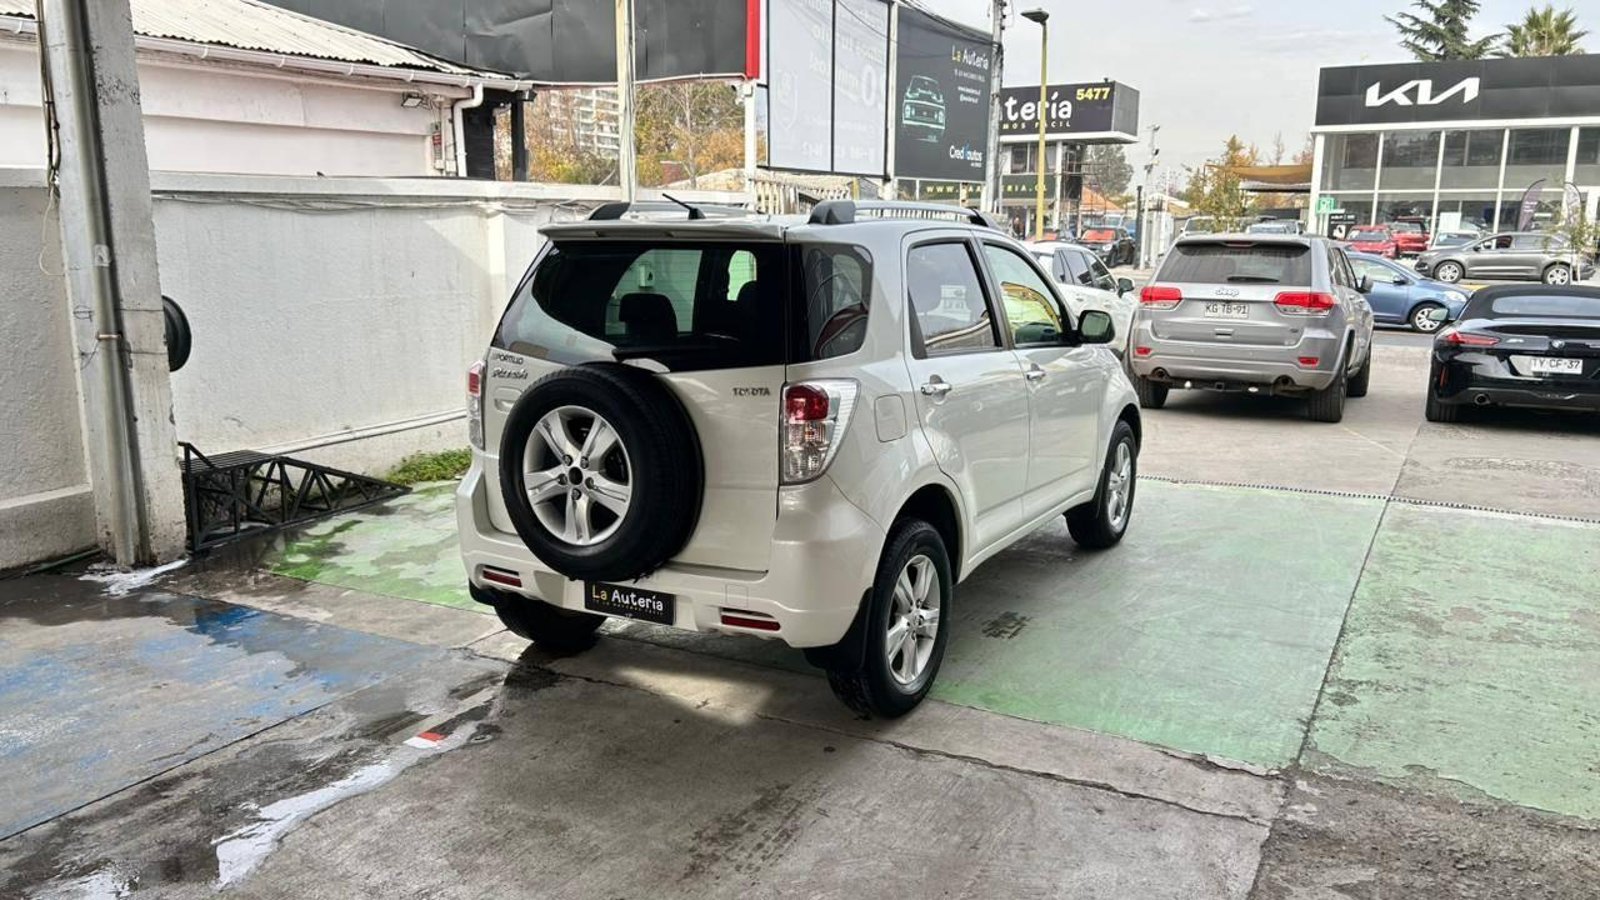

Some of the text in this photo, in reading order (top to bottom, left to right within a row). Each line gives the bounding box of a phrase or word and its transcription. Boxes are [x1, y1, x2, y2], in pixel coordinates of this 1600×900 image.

[952, 45, 961, 62] La
[1076, 87, 1110, 101] 5477
[1365, 77, 1480, 107] KIA
[732, 387, 770, 397] TOYOTA
[592, 584, 608, 601] La
[611, 589, 664, 611] Autería
